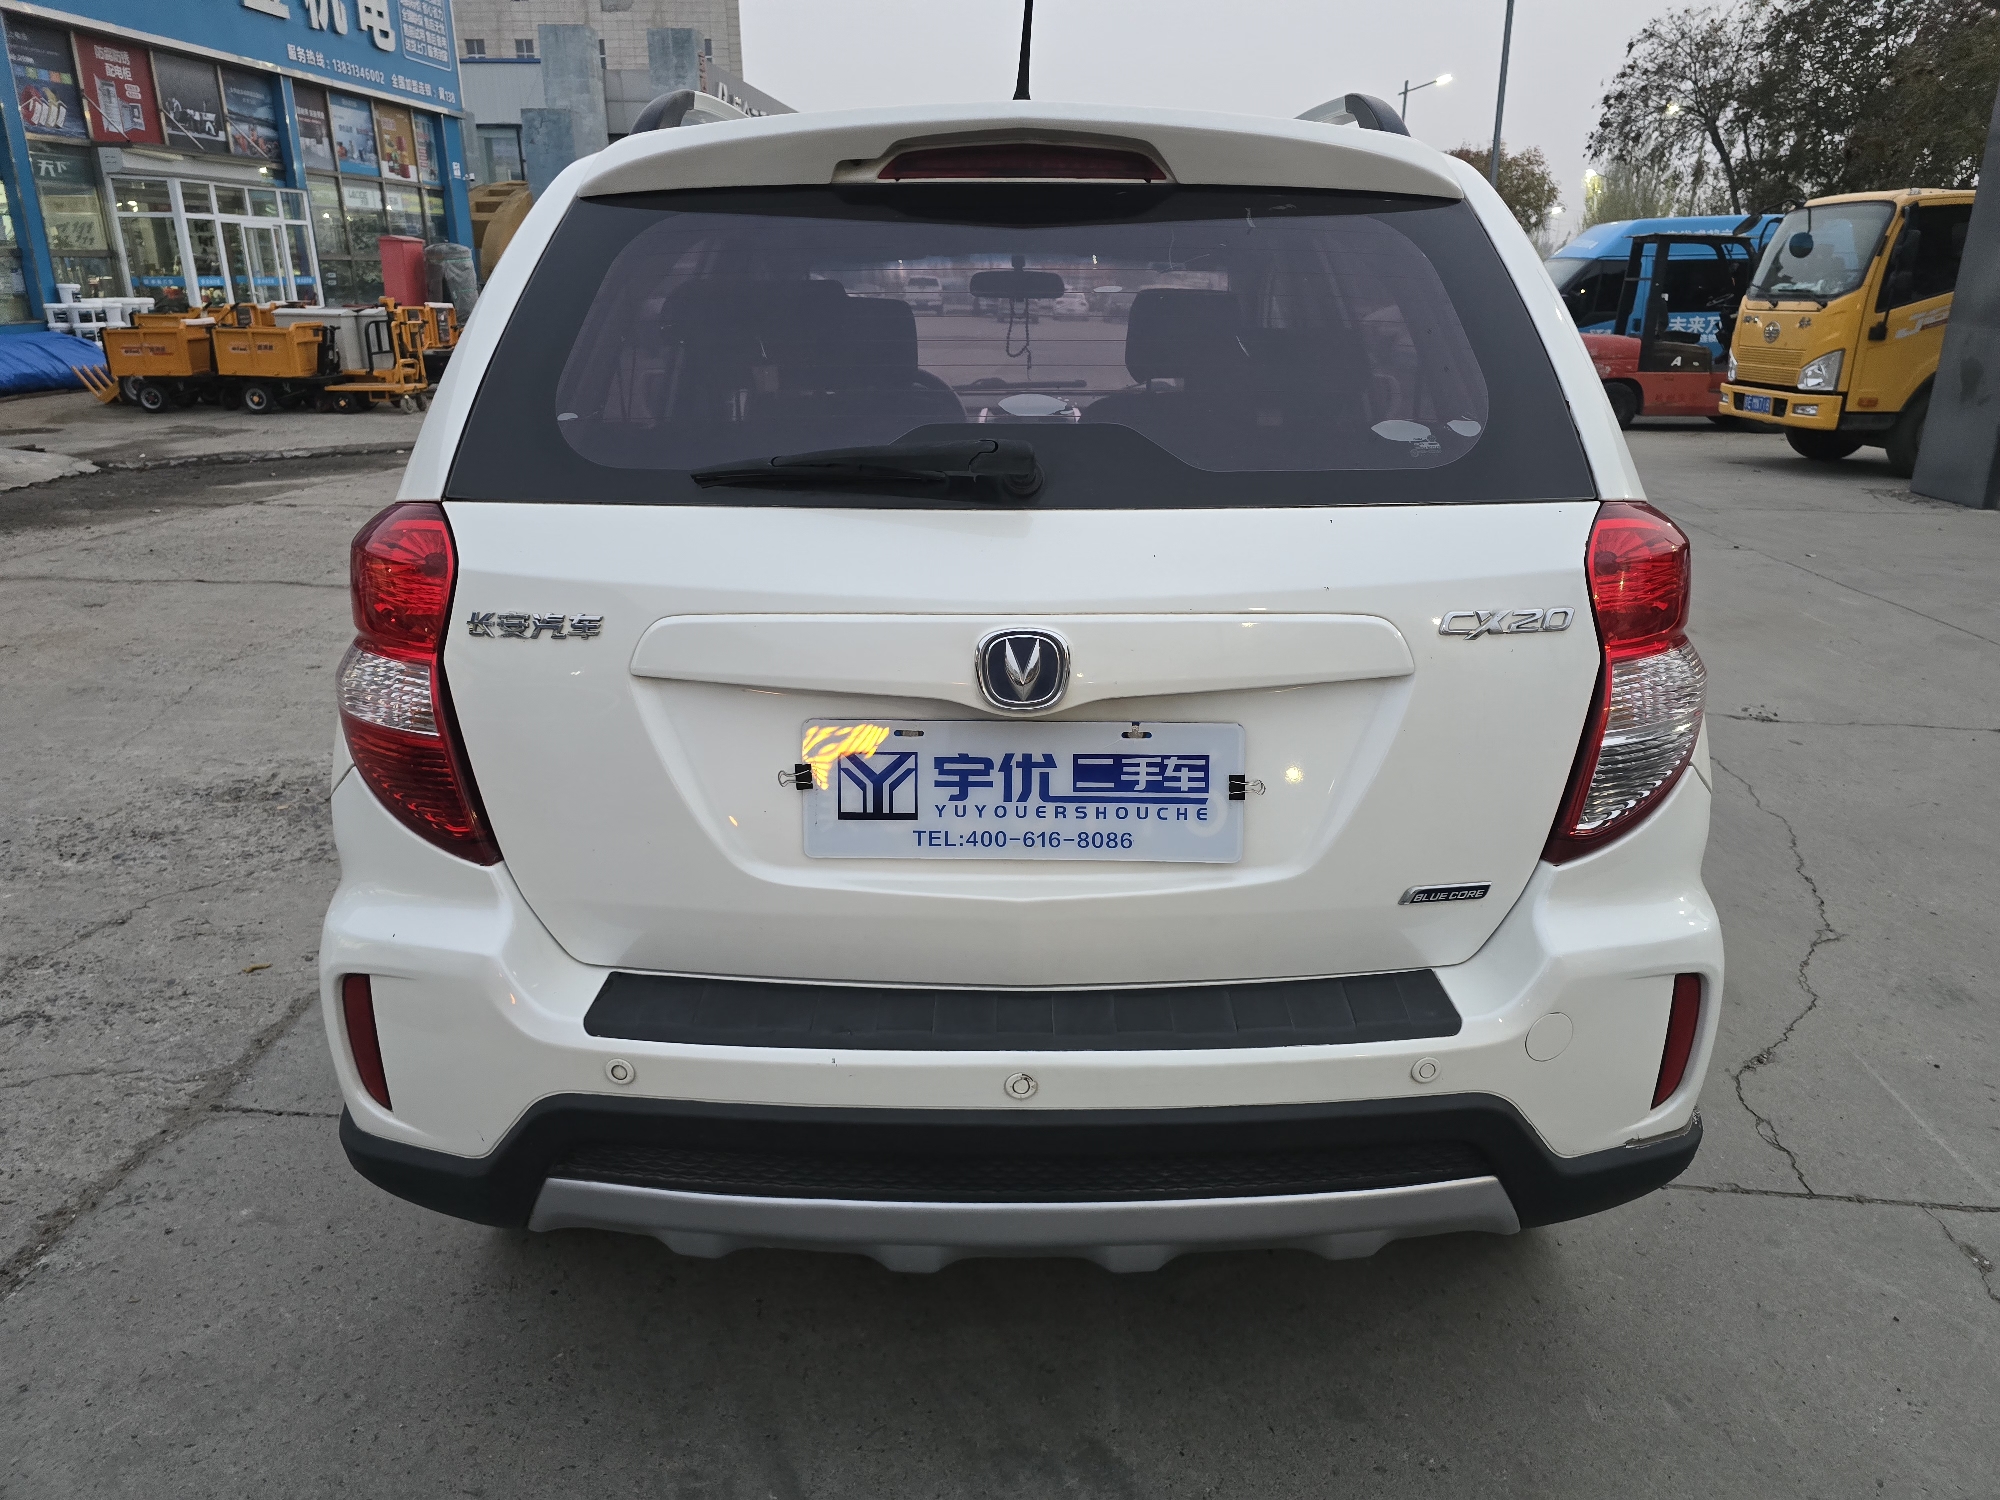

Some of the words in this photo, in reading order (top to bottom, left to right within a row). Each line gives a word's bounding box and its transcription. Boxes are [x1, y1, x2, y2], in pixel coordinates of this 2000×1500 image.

[466, 611, 603, 640] 长安汽车
[1438, 607, 1576, 640] CX20
[934, 804, 1208, 821] YUYOUERSHOUCHE
[912, 830, 1134, 849] TEL:400-616-8086
[1413, 892, 1449, 902] BLUE
[1448, 889, 1486, 900] CORE
